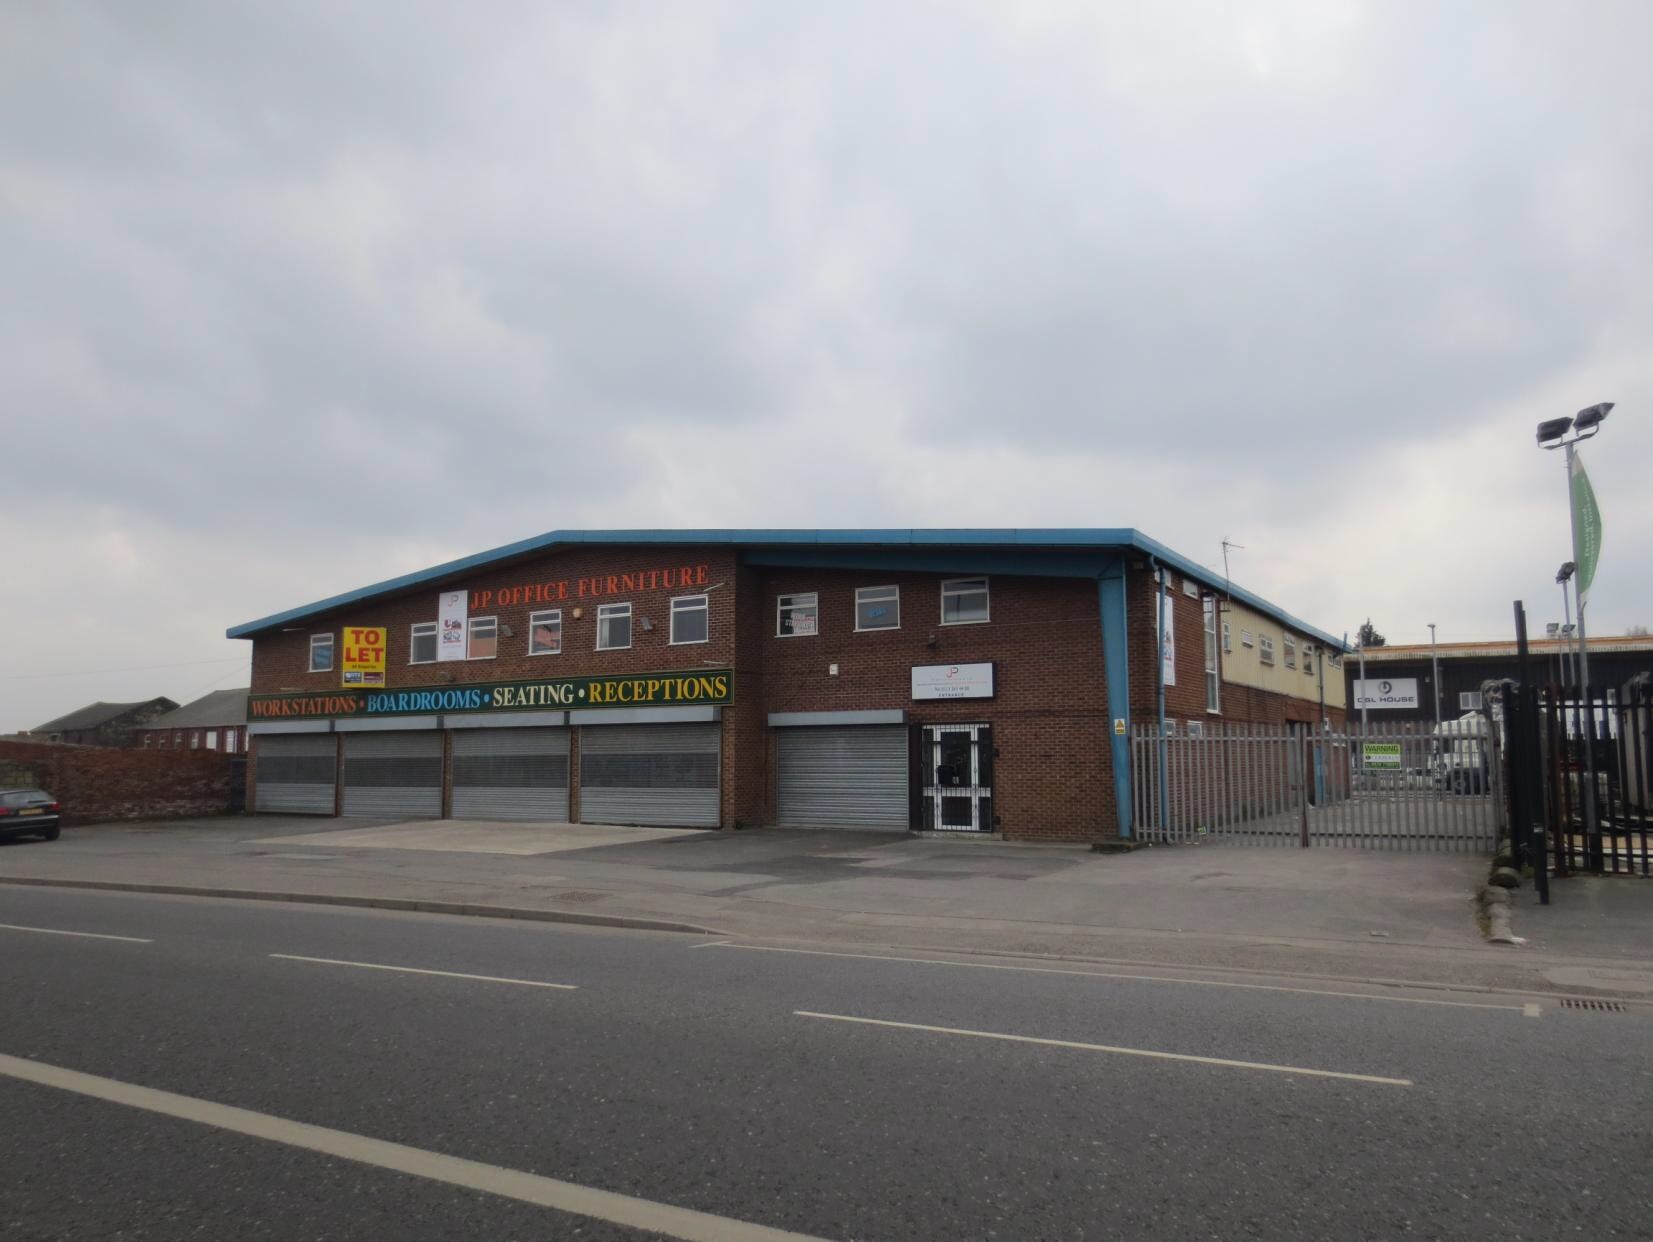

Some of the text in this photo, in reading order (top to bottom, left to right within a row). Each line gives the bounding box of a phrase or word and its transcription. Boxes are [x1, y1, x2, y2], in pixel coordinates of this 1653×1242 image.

[470, 565, 710, 609] JP OFFICE FURNITURE
[351, 629, 380, 645] TO
[345, 647, 384, 663] LET
[251, 676, 727, 717] WORKSTATIONS BOARDROOMS SEATING RECEPTIONS
[1364, 745, 1399, 753] WARNING
